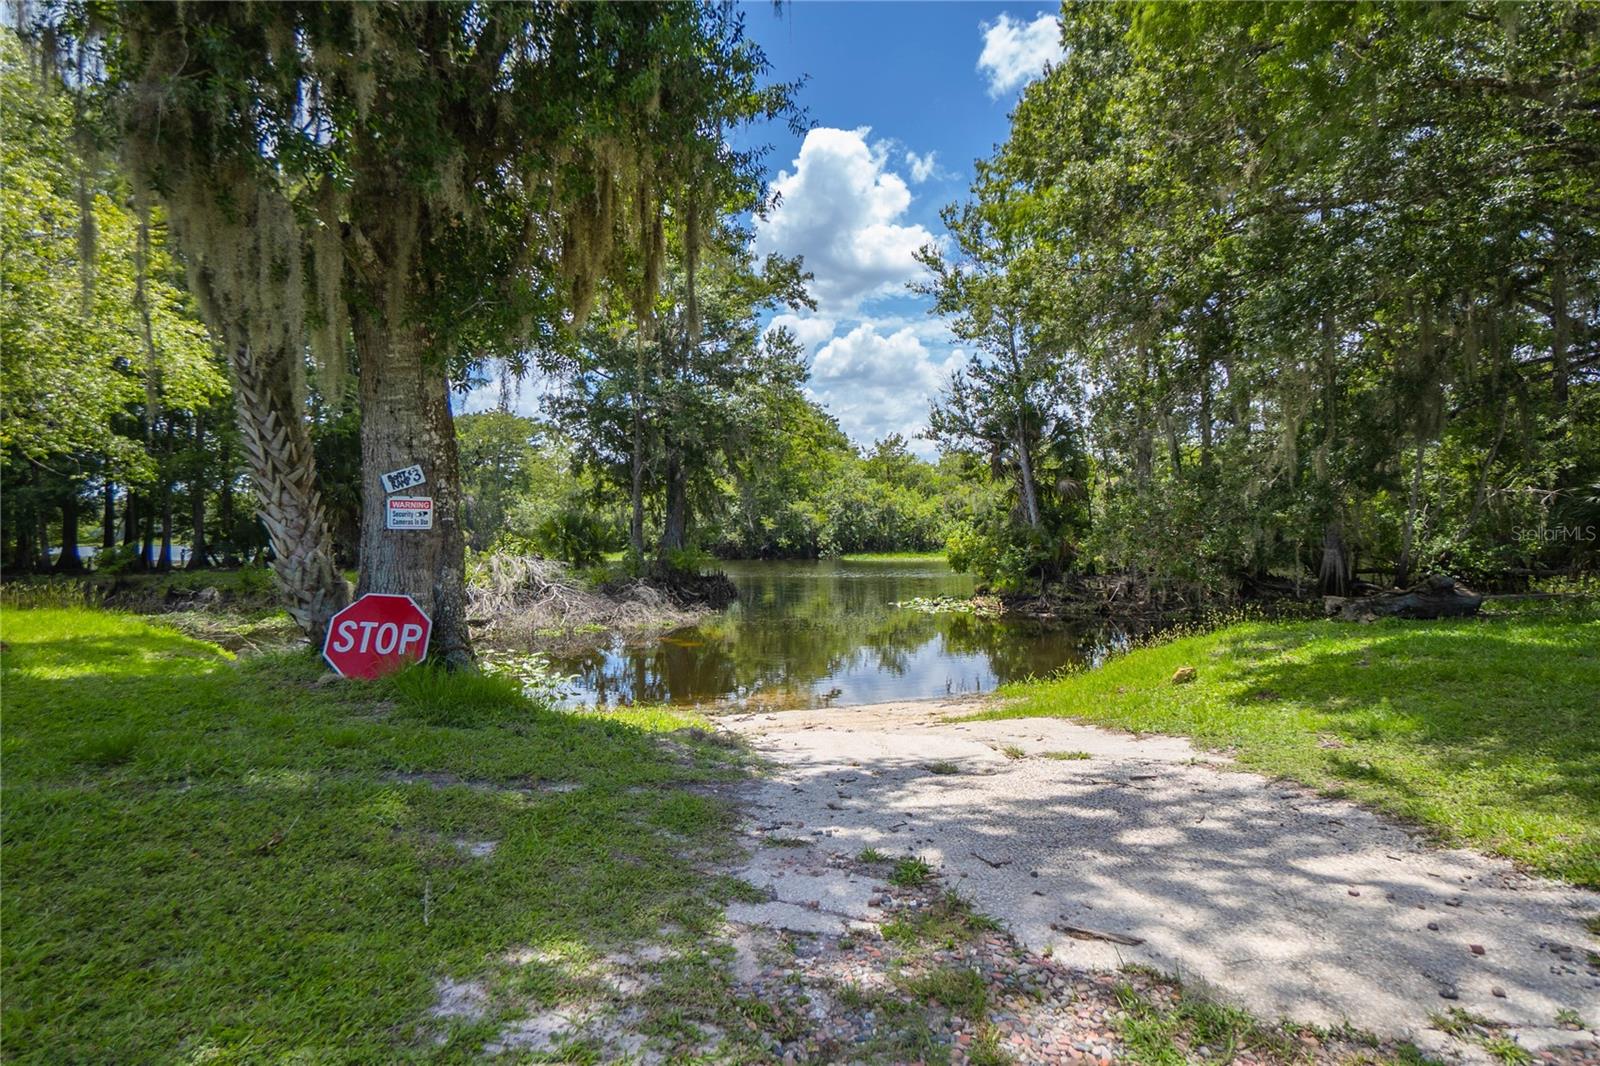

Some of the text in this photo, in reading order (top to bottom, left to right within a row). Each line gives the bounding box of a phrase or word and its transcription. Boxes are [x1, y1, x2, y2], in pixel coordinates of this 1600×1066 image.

[391, 501, 429, 509] WARNING
[392, 511, 414, 519] Security
[333, 620, 423, 655] STOP
